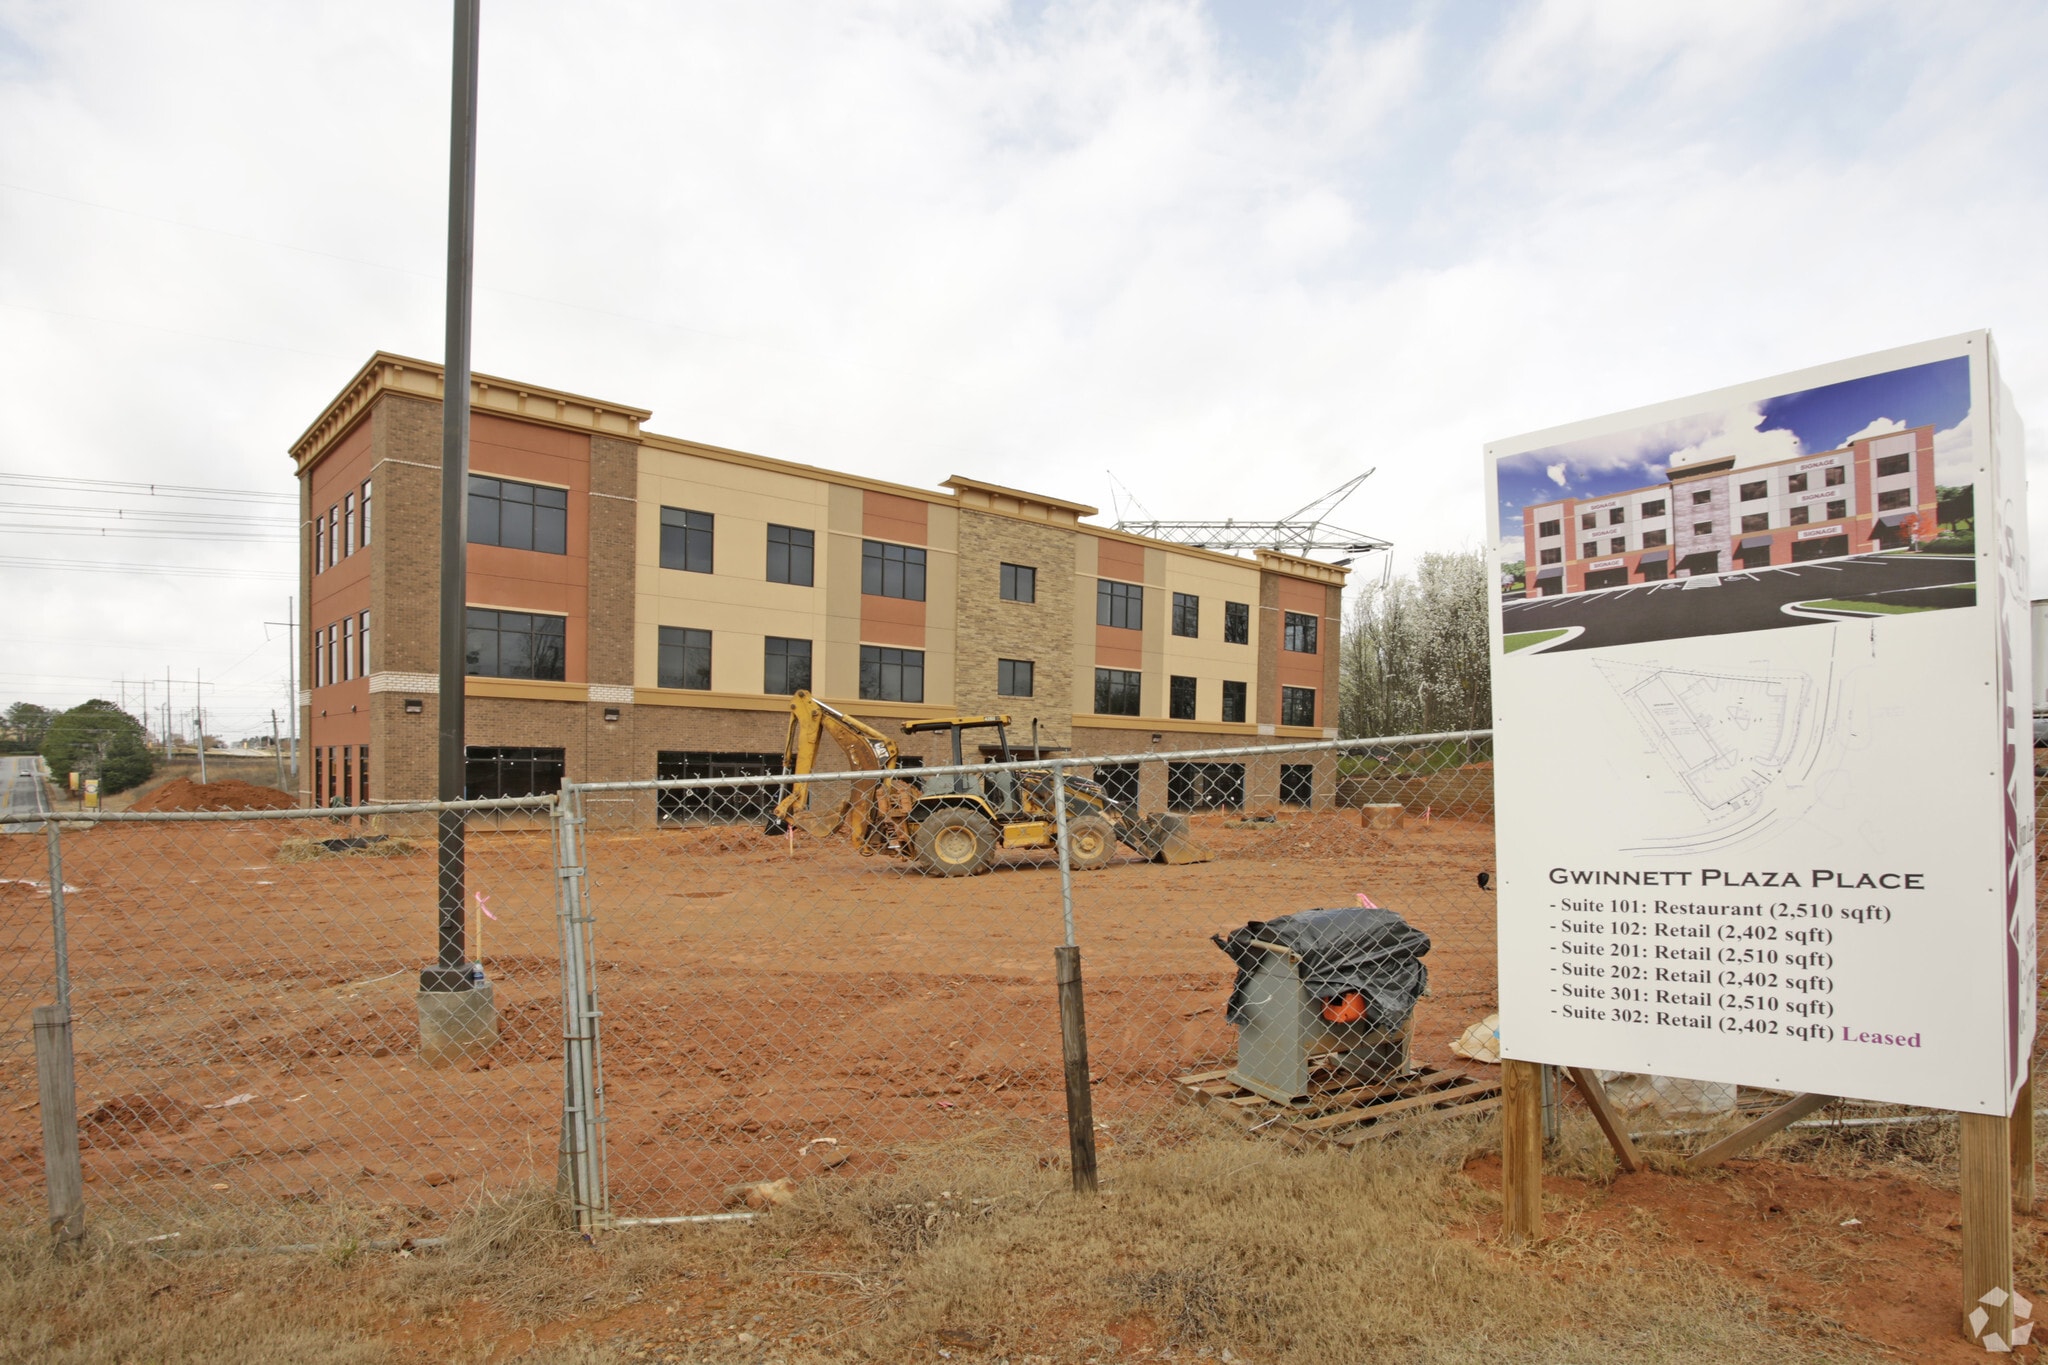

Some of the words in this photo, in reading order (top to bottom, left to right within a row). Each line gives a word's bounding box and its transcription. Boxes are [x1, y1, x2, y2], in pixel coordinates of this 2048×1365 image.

[1800, 458, 1835, 471] SIGNAGE
[1802, 490, 1836, 502] SIGNAGE
[1803, 527, 1838, 539] SIGNAGE
[873, 741, 890, 759] CAT
[1548, 867, 1693, 886] GWINNETT
[1701, 868, 1802, 888] PLAZA
[1811, 869, 1925, 890] PLACE
[1561, 898, 1604, 914] Suite
[1611, 899, 1647, 914] 101:
[1654, 900, 1763, 917] Restaurant
[1769, 902, 1834, 921] (2,510
[1840, 904, 1892, 924] sqft)
[1561, 919, 1604, 935] Suite
[1611, 921, 1647, 936] 102:
[1655, 922, 1711, 939] Retail
[1717, 924, 1778, 943] (2,402
[1785, 927, 1833, 946] sqft)
[1562, 940, 1605, 956] Suite
[1611, 943, 1647, 958] 201:
[1655, 945, 1711, 961] Retail
[1717, 947, 1779, 966] (2,510
[1785, 950, 1834, 970] sqft)
[1562, 962, 1605, 978] Suite
[1611, 964, 1648, 981] 202:
[1655, 967, 1711, 984] Retail
[1718, 970, 1778, 989] (2,402
[1785, 975, 1834, 994] sqft)
[1562, 983, 1606, 999] Suite
[1611, 985, 1648, 1002] 301:
[1656, 989, 1712, 1007] Retail
[1718, 993, 1779, 1012] (2,510
[1785, 999, 1834, 1018] sqft)
[1562, 1004, 1606, 1021] Suite
[1611, 1008, 1649, 1024] 302:
[1656, 1011, 1712, 1030] Retail
[1718, 1016, 1779, 1036] (2,402
[1786, 1023, 1834, 1043] sqft)
[1843, 1026, 1921, 1048] Leased
